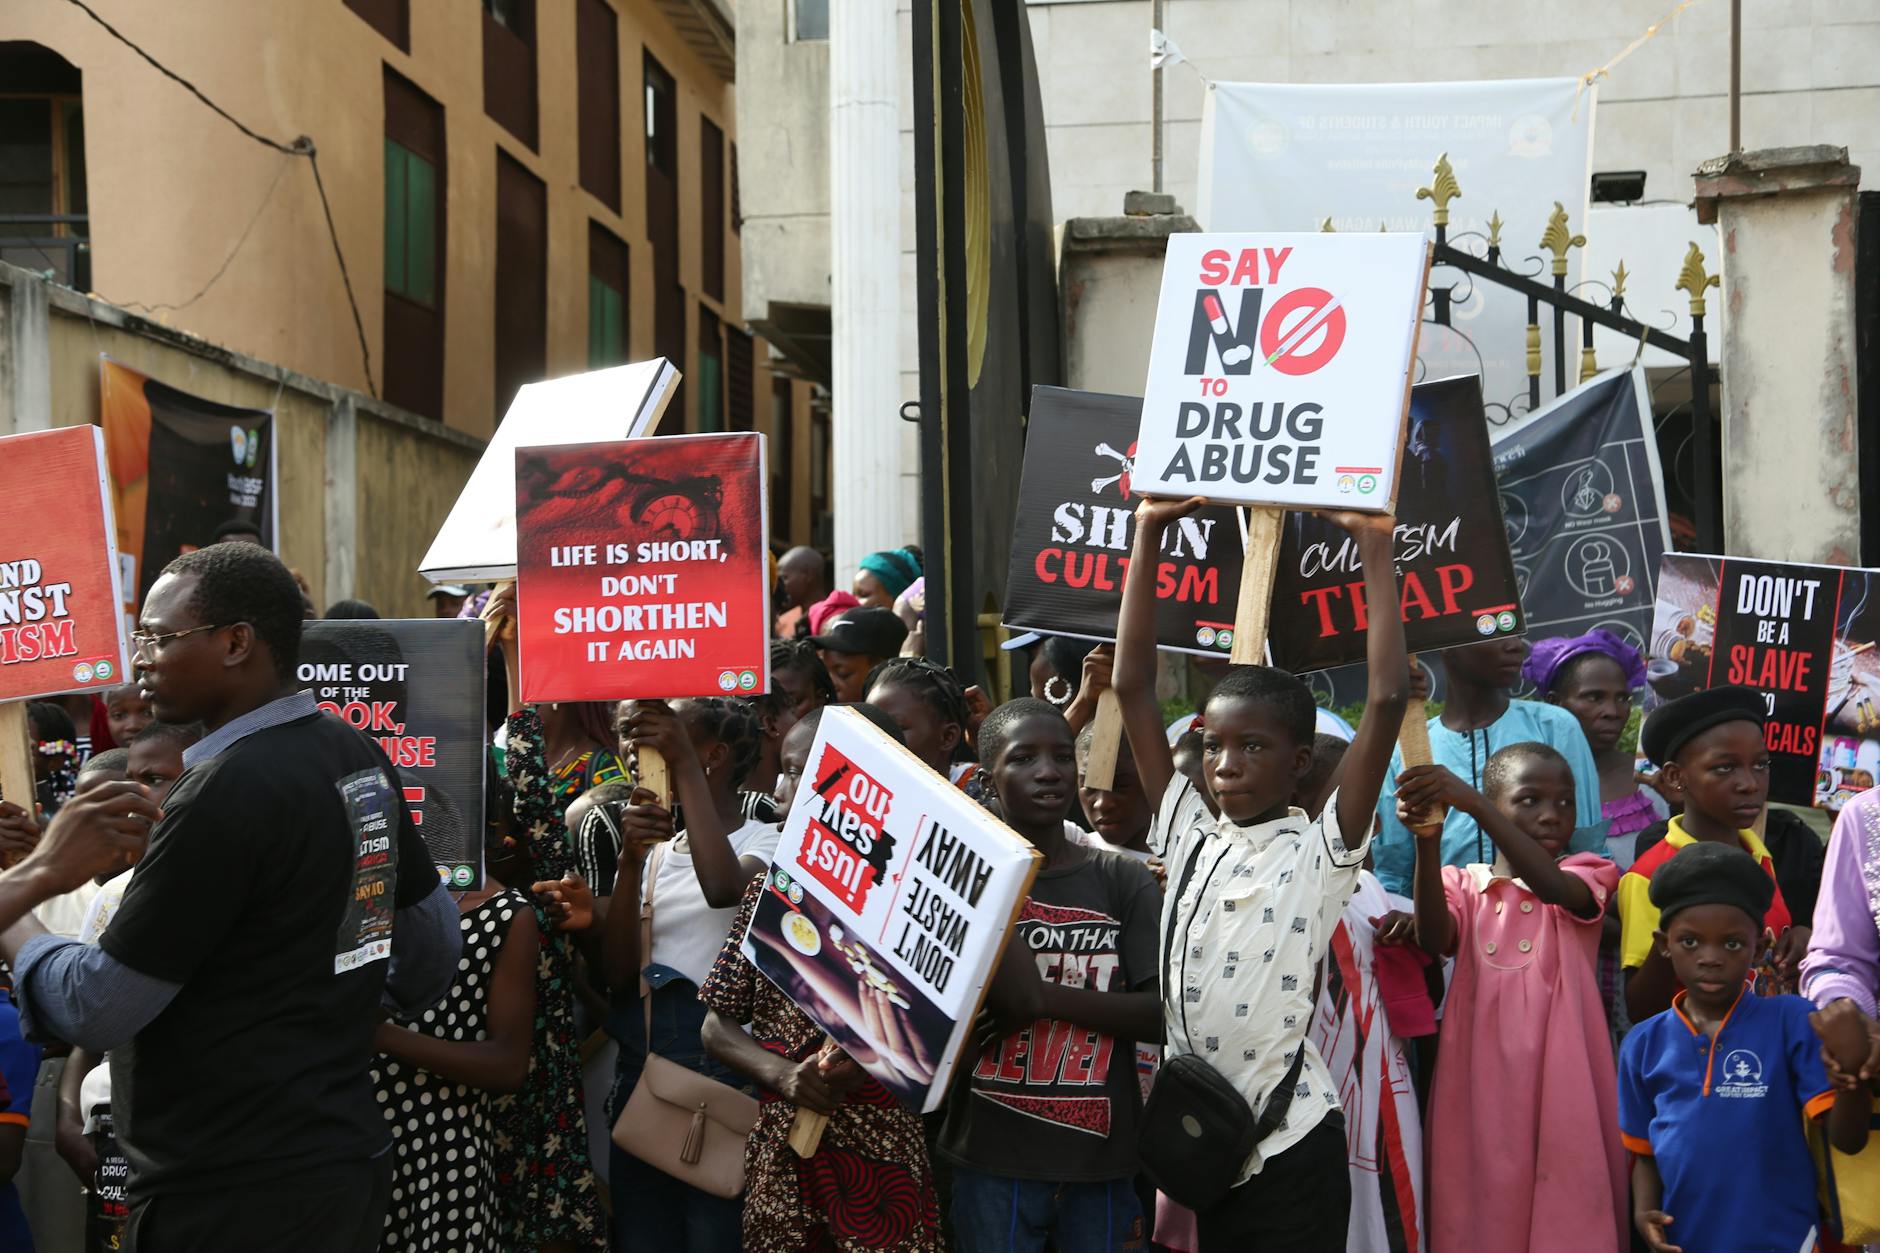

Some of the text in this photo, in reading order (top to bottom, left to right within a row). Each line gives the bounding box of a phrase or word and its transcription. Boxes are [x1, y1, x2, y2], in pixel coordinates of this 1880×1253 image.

[1200, 247, 1293, 286] SAY
[1184, 287, 1346, 376] NO
[1200, 378, 1228, 397] TO
[1175, 401, 1324, 442] DRUG
[1159, 441, 1321, 485] ABUSE
[1051, 502, 1216, 560] SHN
[551, 539, 728, 567] LIFE IS SHORT,
[601, 574, 678, 597] DON'T
[1736, 574, 1820, 621] DON'T
[553, 601, 728, 635] SHORTHEN
[1756, 619, 1789, 645] BE A
[587, 638, 695, 662] IT AGAIN
[1728, 644, 1812, 692] SLAVE
[320, 686, 370, 698] OF THE
[358, 663, 409, 682] OUT
[849, 773, 889, 821] no
[821, 792, 877, 855] say
[806, 827, 870, 902] just
[915, 821, 994, 909] AWAY
[903, 876, 970, 958] WASTE
[893, 921, 955, 994] DON'T
[1028, 927, 1120, 950] ON THAT
[102, 1165, 128, 1177] DRUG
